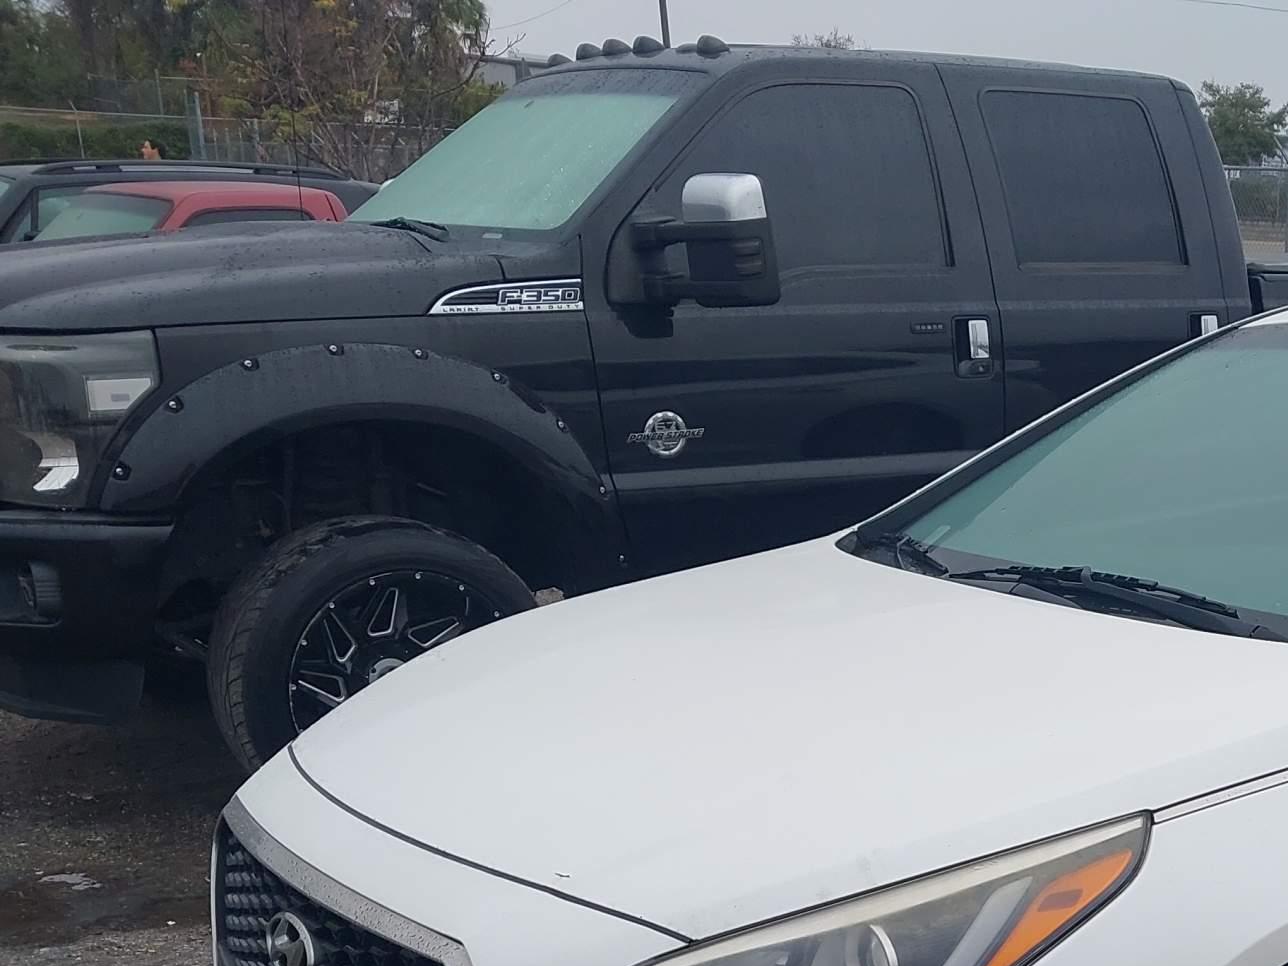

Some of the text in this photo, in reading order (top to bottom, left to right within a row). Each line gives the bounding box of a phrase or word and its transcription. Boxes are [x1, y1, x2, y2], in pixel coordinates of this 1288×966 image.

[497, 288, 580, 305] F-350
[627, 427, 705, 443] POWER STROKE
